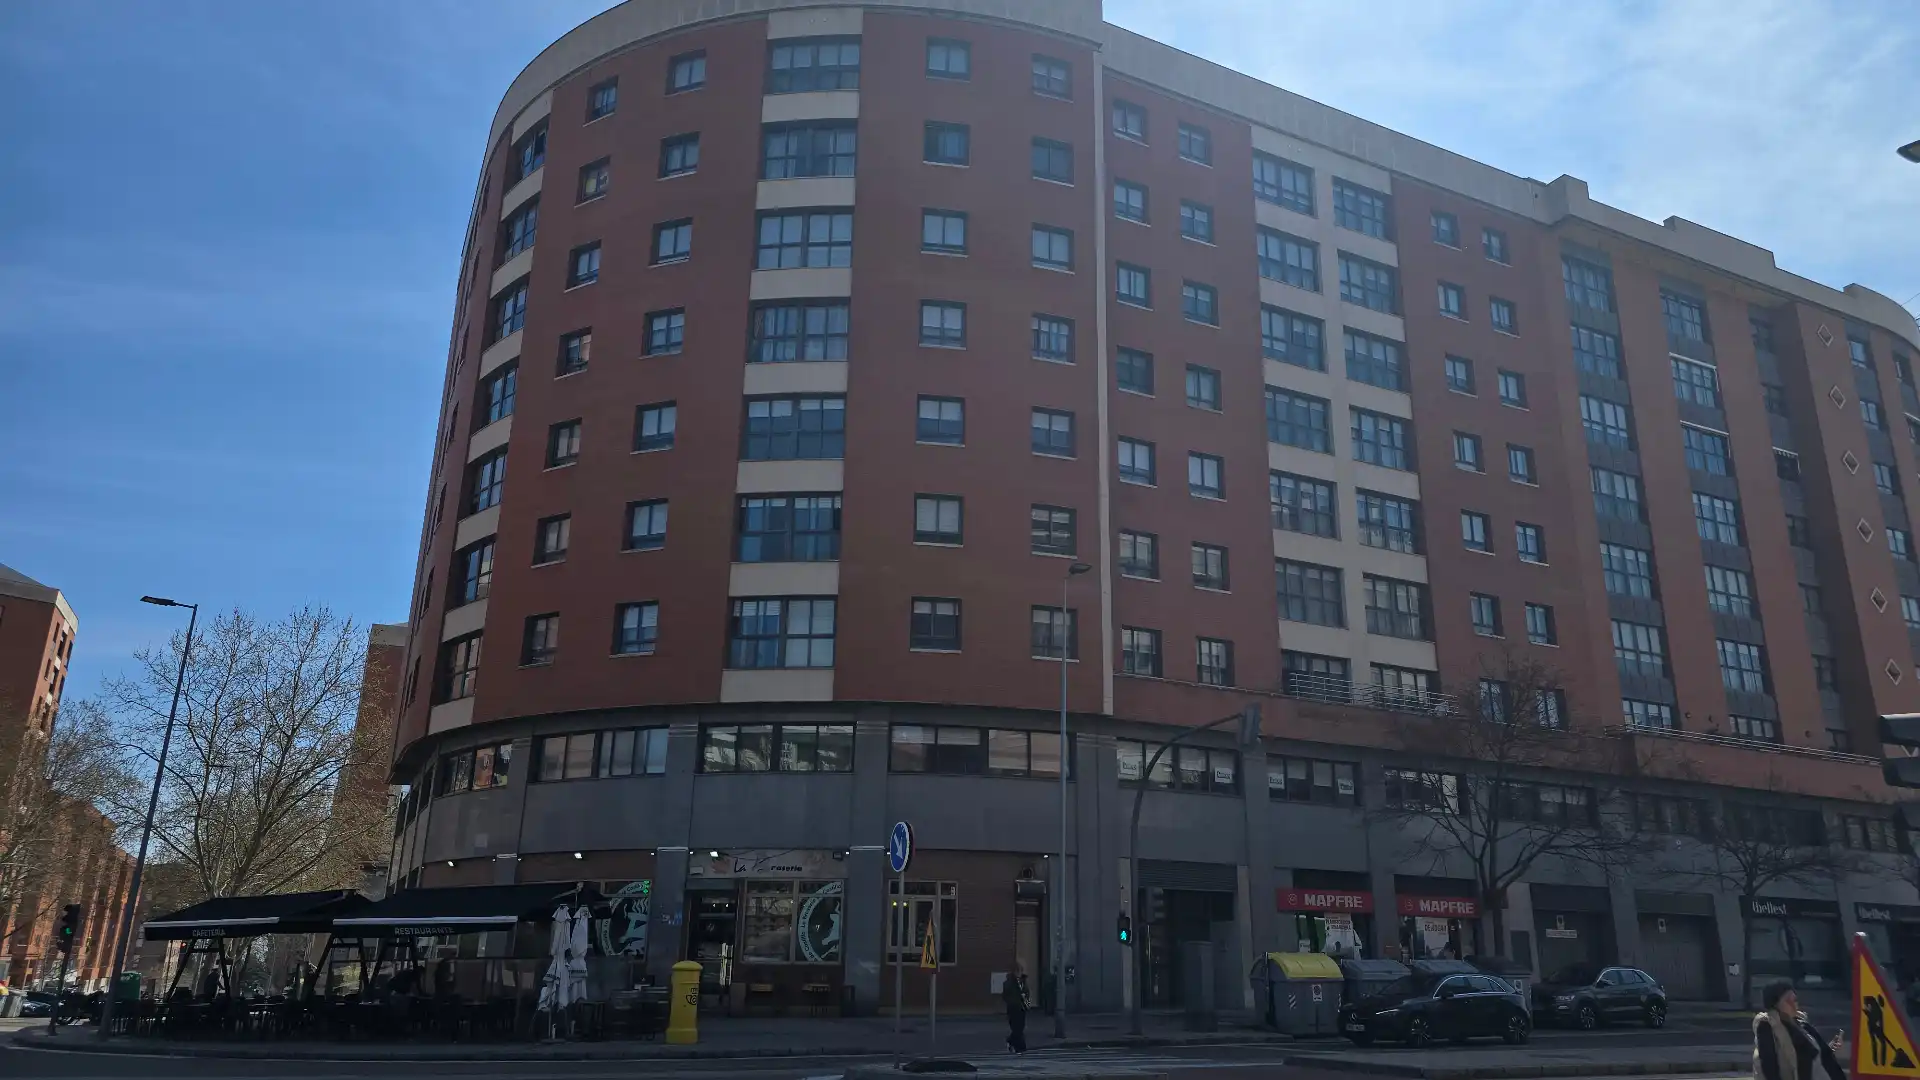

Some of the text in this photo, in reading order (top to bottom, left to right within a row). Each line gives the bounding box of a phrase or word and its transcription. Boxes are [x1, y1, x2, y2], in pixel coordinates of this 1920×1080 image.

[1304, 893, 1363, 908] MAPFRE
[1419, 899, 1474, 914] MAPFRE
[394, 927, 455, 936] RESTAURANTE
